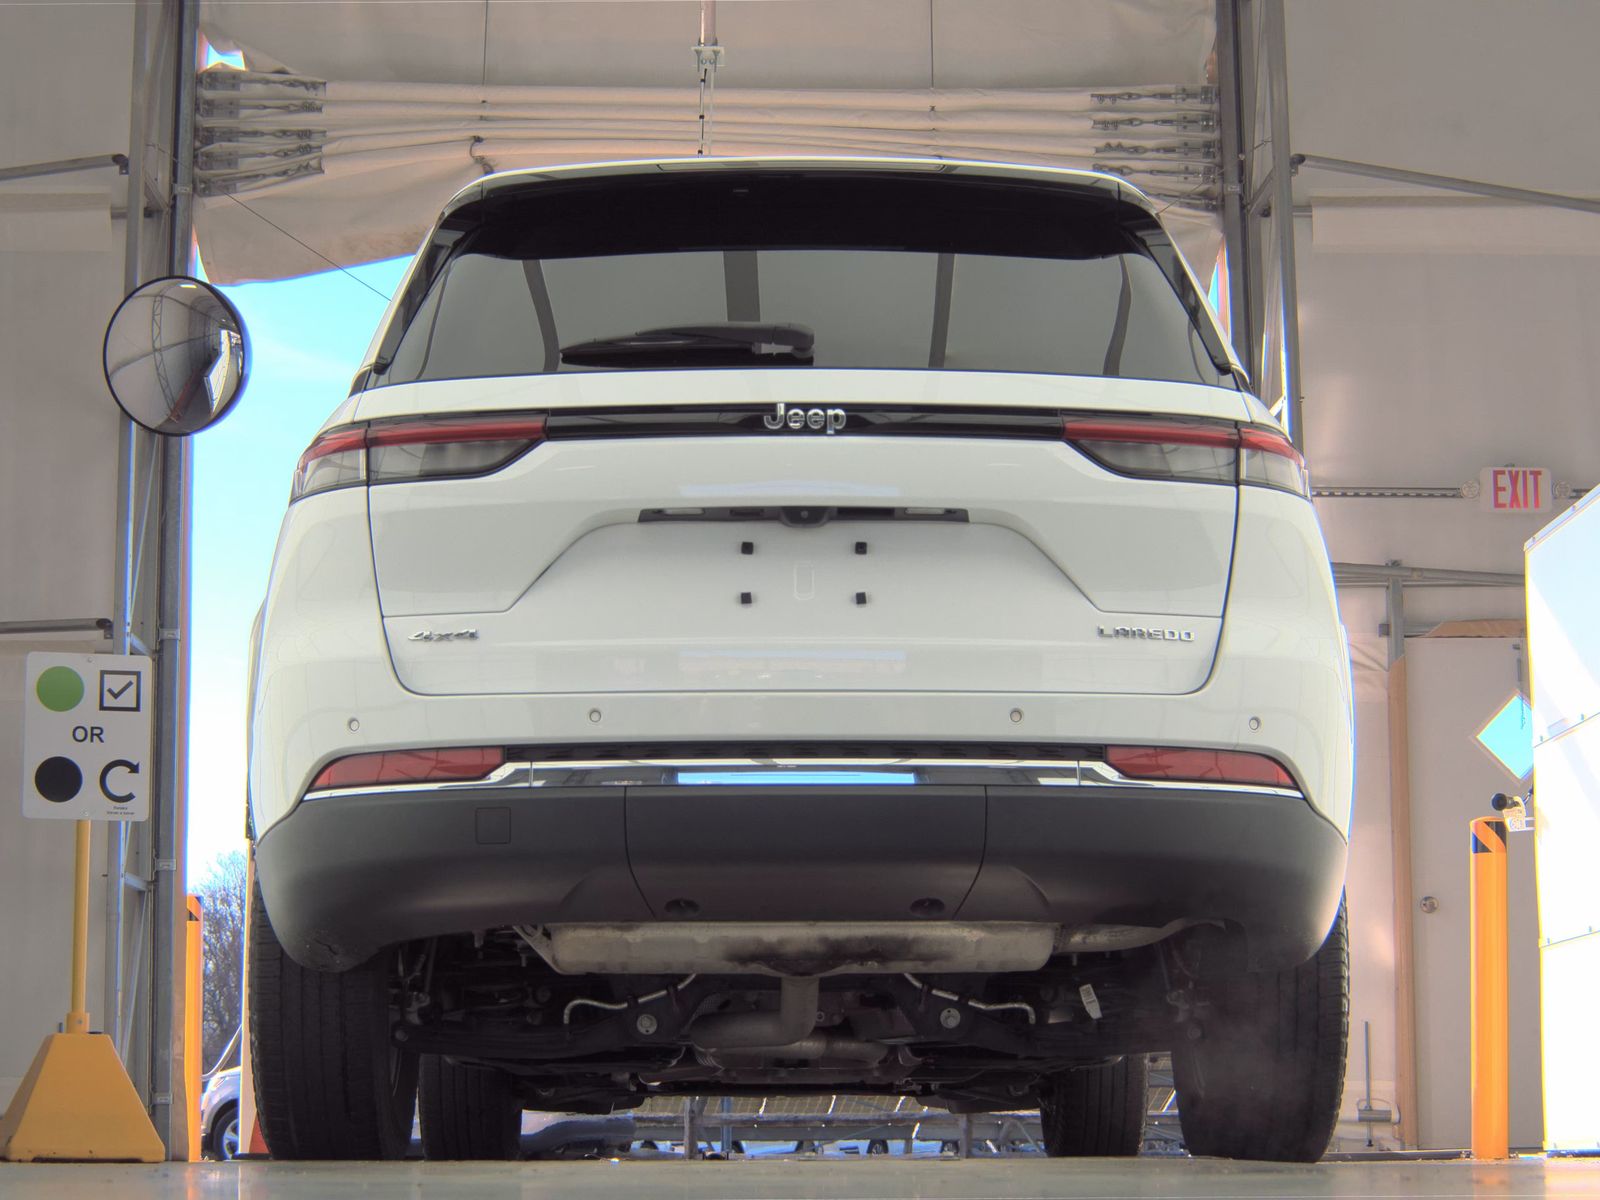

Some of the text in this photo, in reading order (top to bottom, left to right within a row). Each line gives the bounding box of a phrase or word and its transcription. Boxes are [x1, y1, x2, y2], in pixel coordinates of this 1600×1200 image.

[763, 402, 847, 435] Jeep
[1492, 469, 1542, 509] EXIT
[407, 628, 479, 642] 4x4
[1097, 626, 1195, 643] LAREDO
[72, 725, 105, 743] OR
